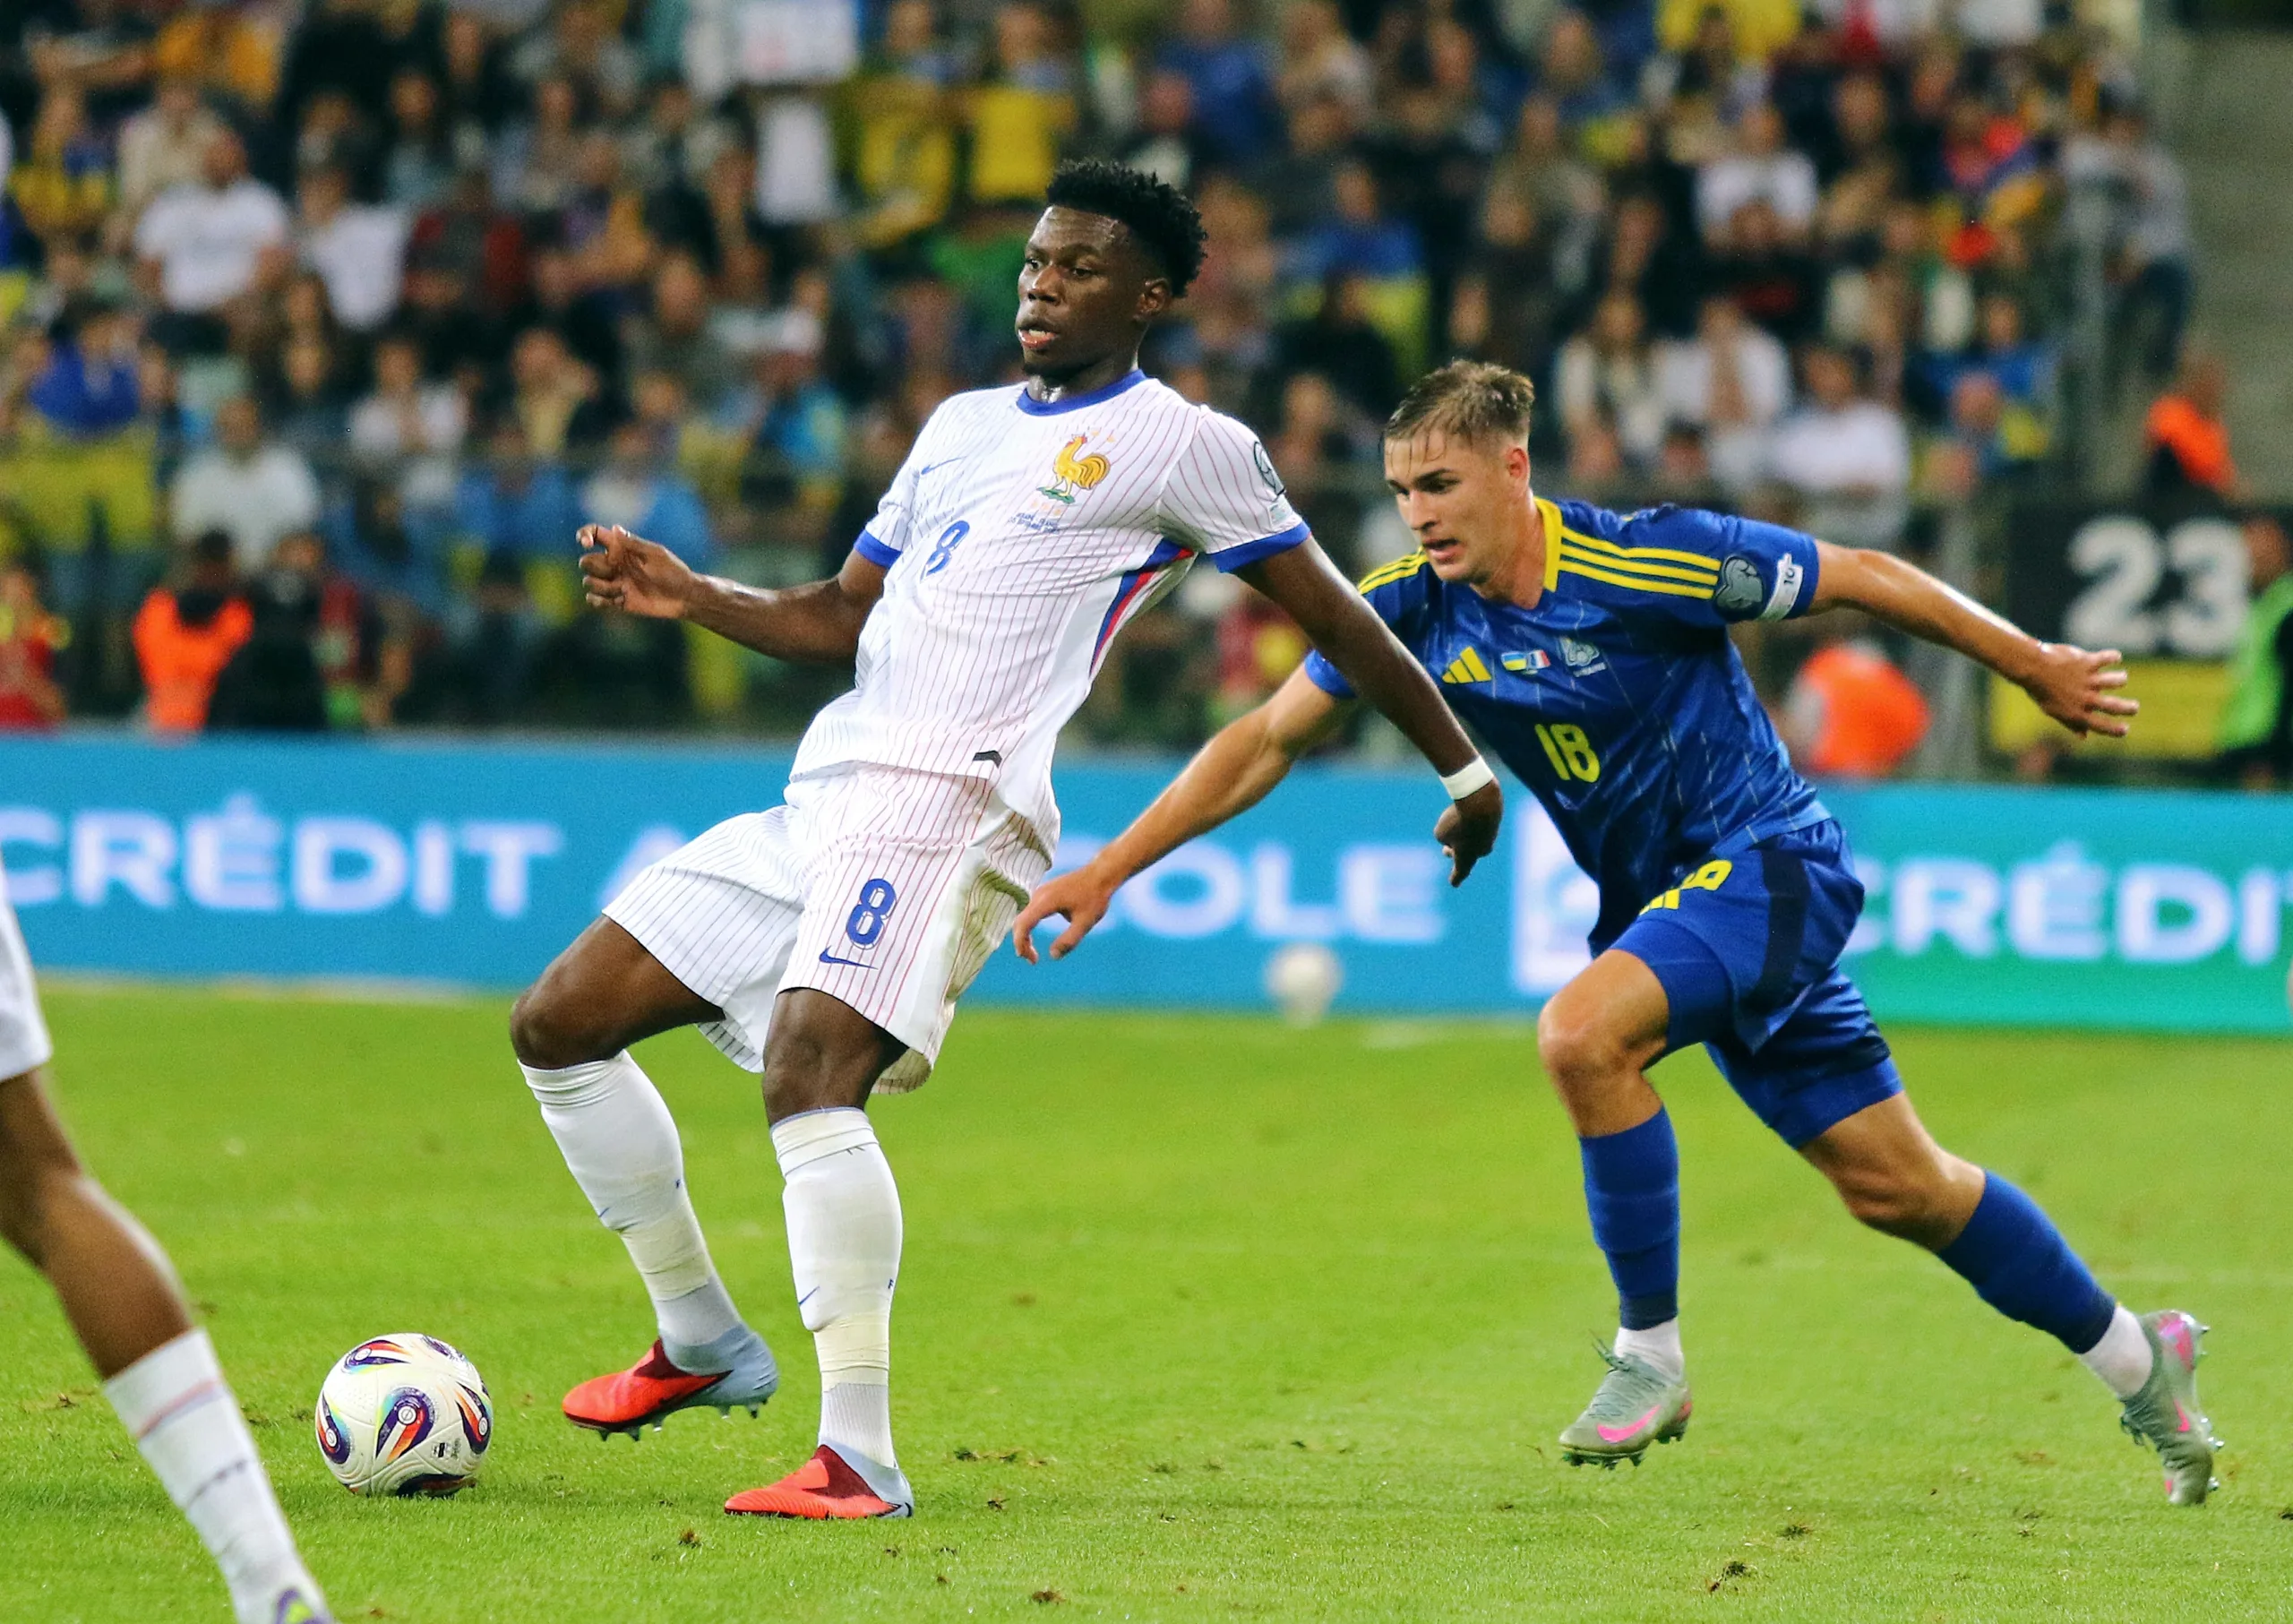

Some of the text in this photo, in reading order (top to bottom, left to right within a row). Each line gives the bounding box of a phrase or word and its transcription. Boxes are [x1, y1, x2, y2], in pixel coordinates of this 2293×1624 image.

[920, 520, 970, 580] 8
[2067, 517, 2250, 656] 23
[1534, 724, 1600, 783] 18
[846, 878, 897, 947] 8
[1843, 840, 2293, 965] RÉDI
